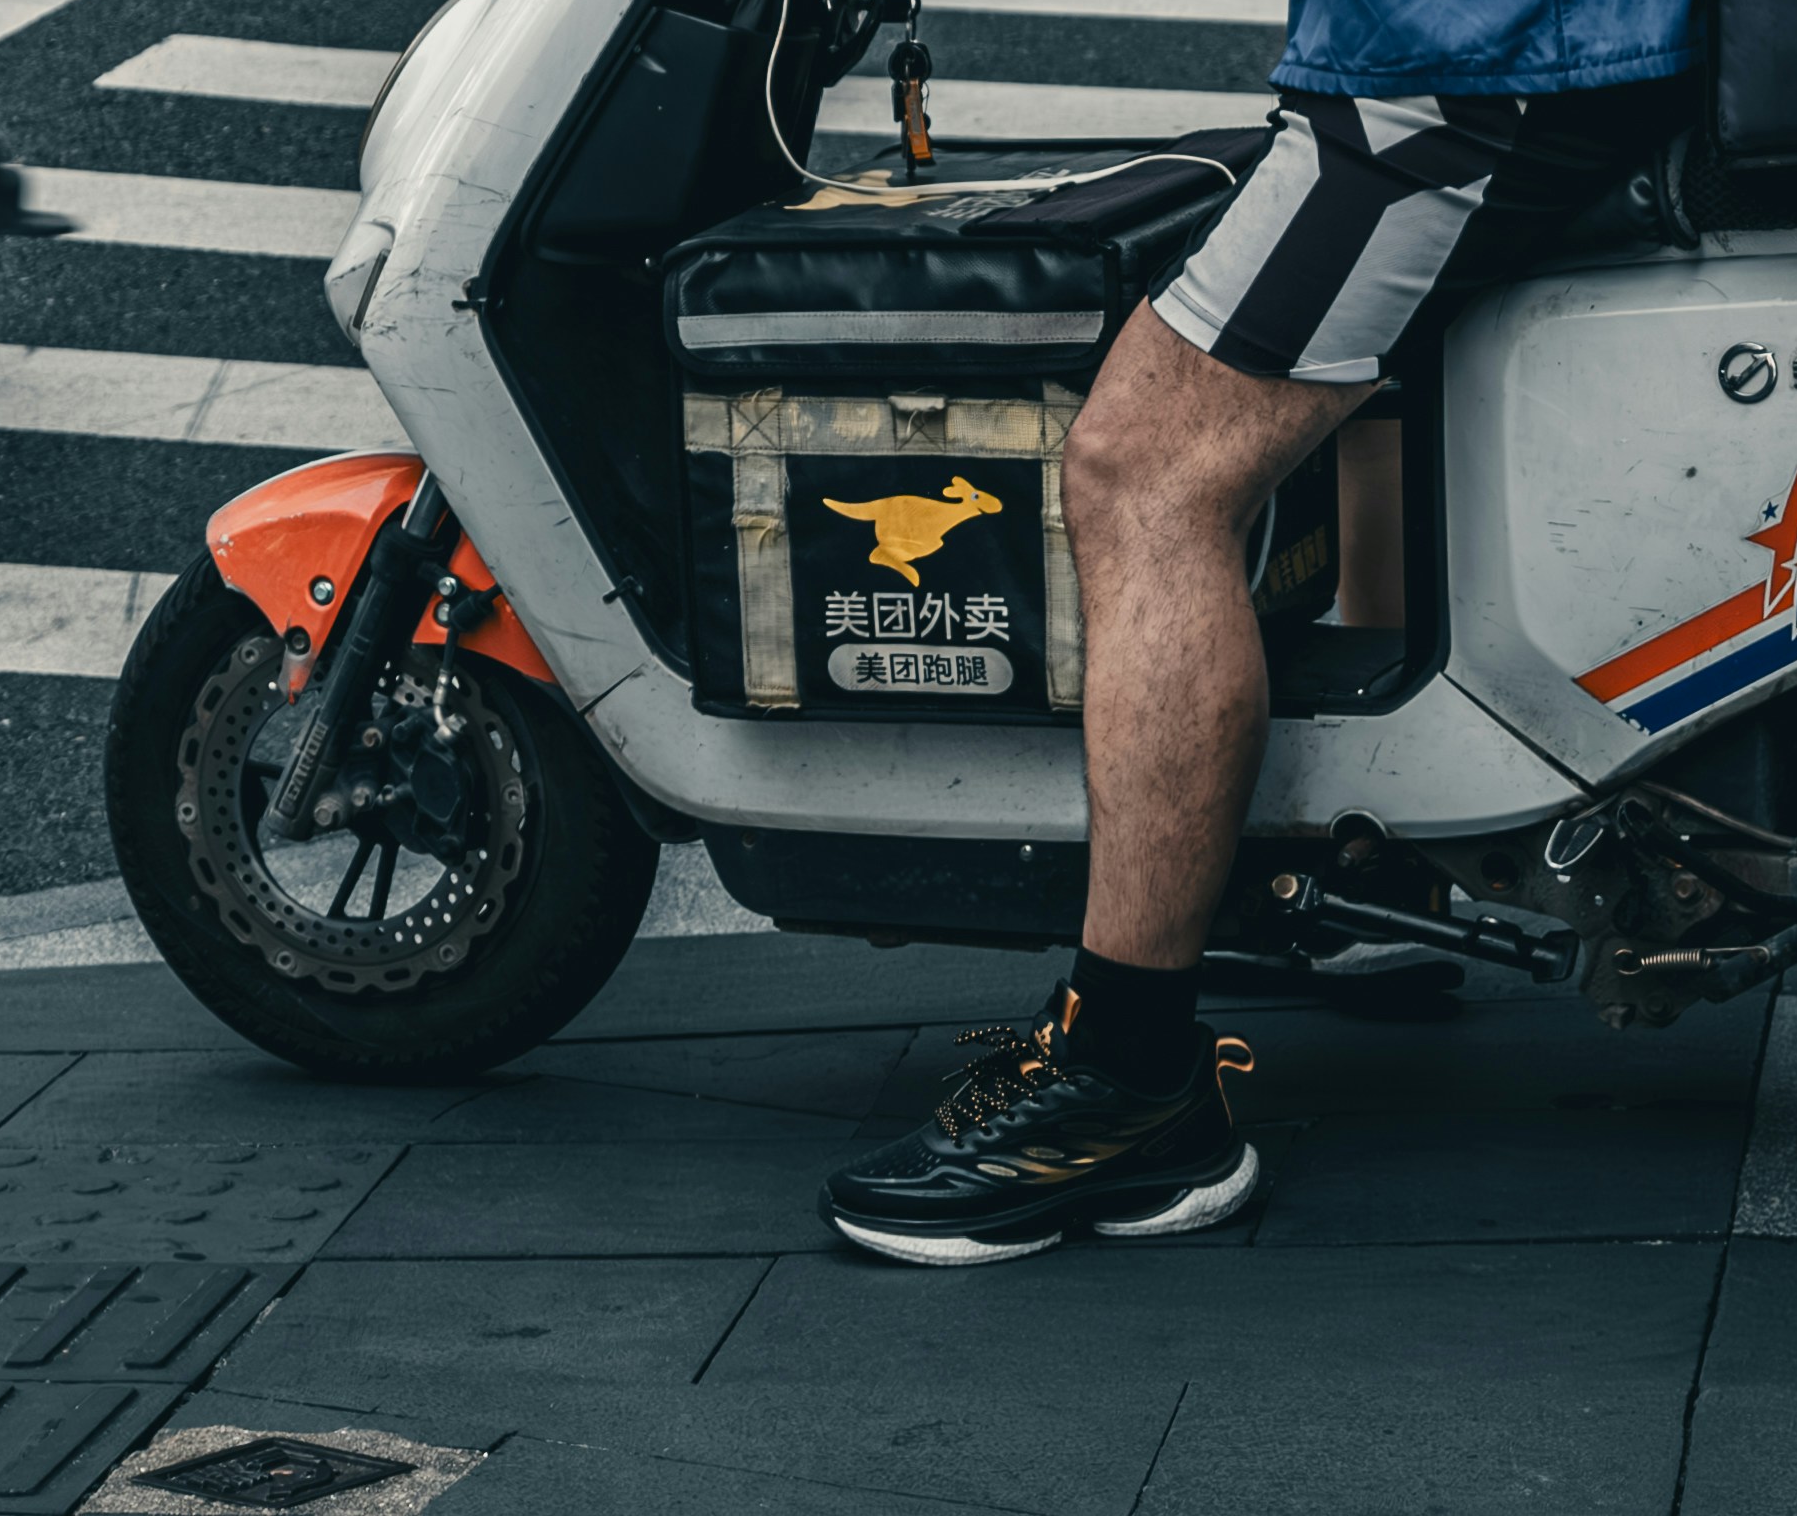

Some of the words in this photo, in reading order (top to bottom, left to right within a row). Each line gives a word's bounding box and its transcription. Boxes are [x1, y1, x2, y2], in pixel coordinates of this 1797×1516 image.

[825, 590, 1011, 641] 美团外卖
[855, 652, 989, 687] 美团跑腿
